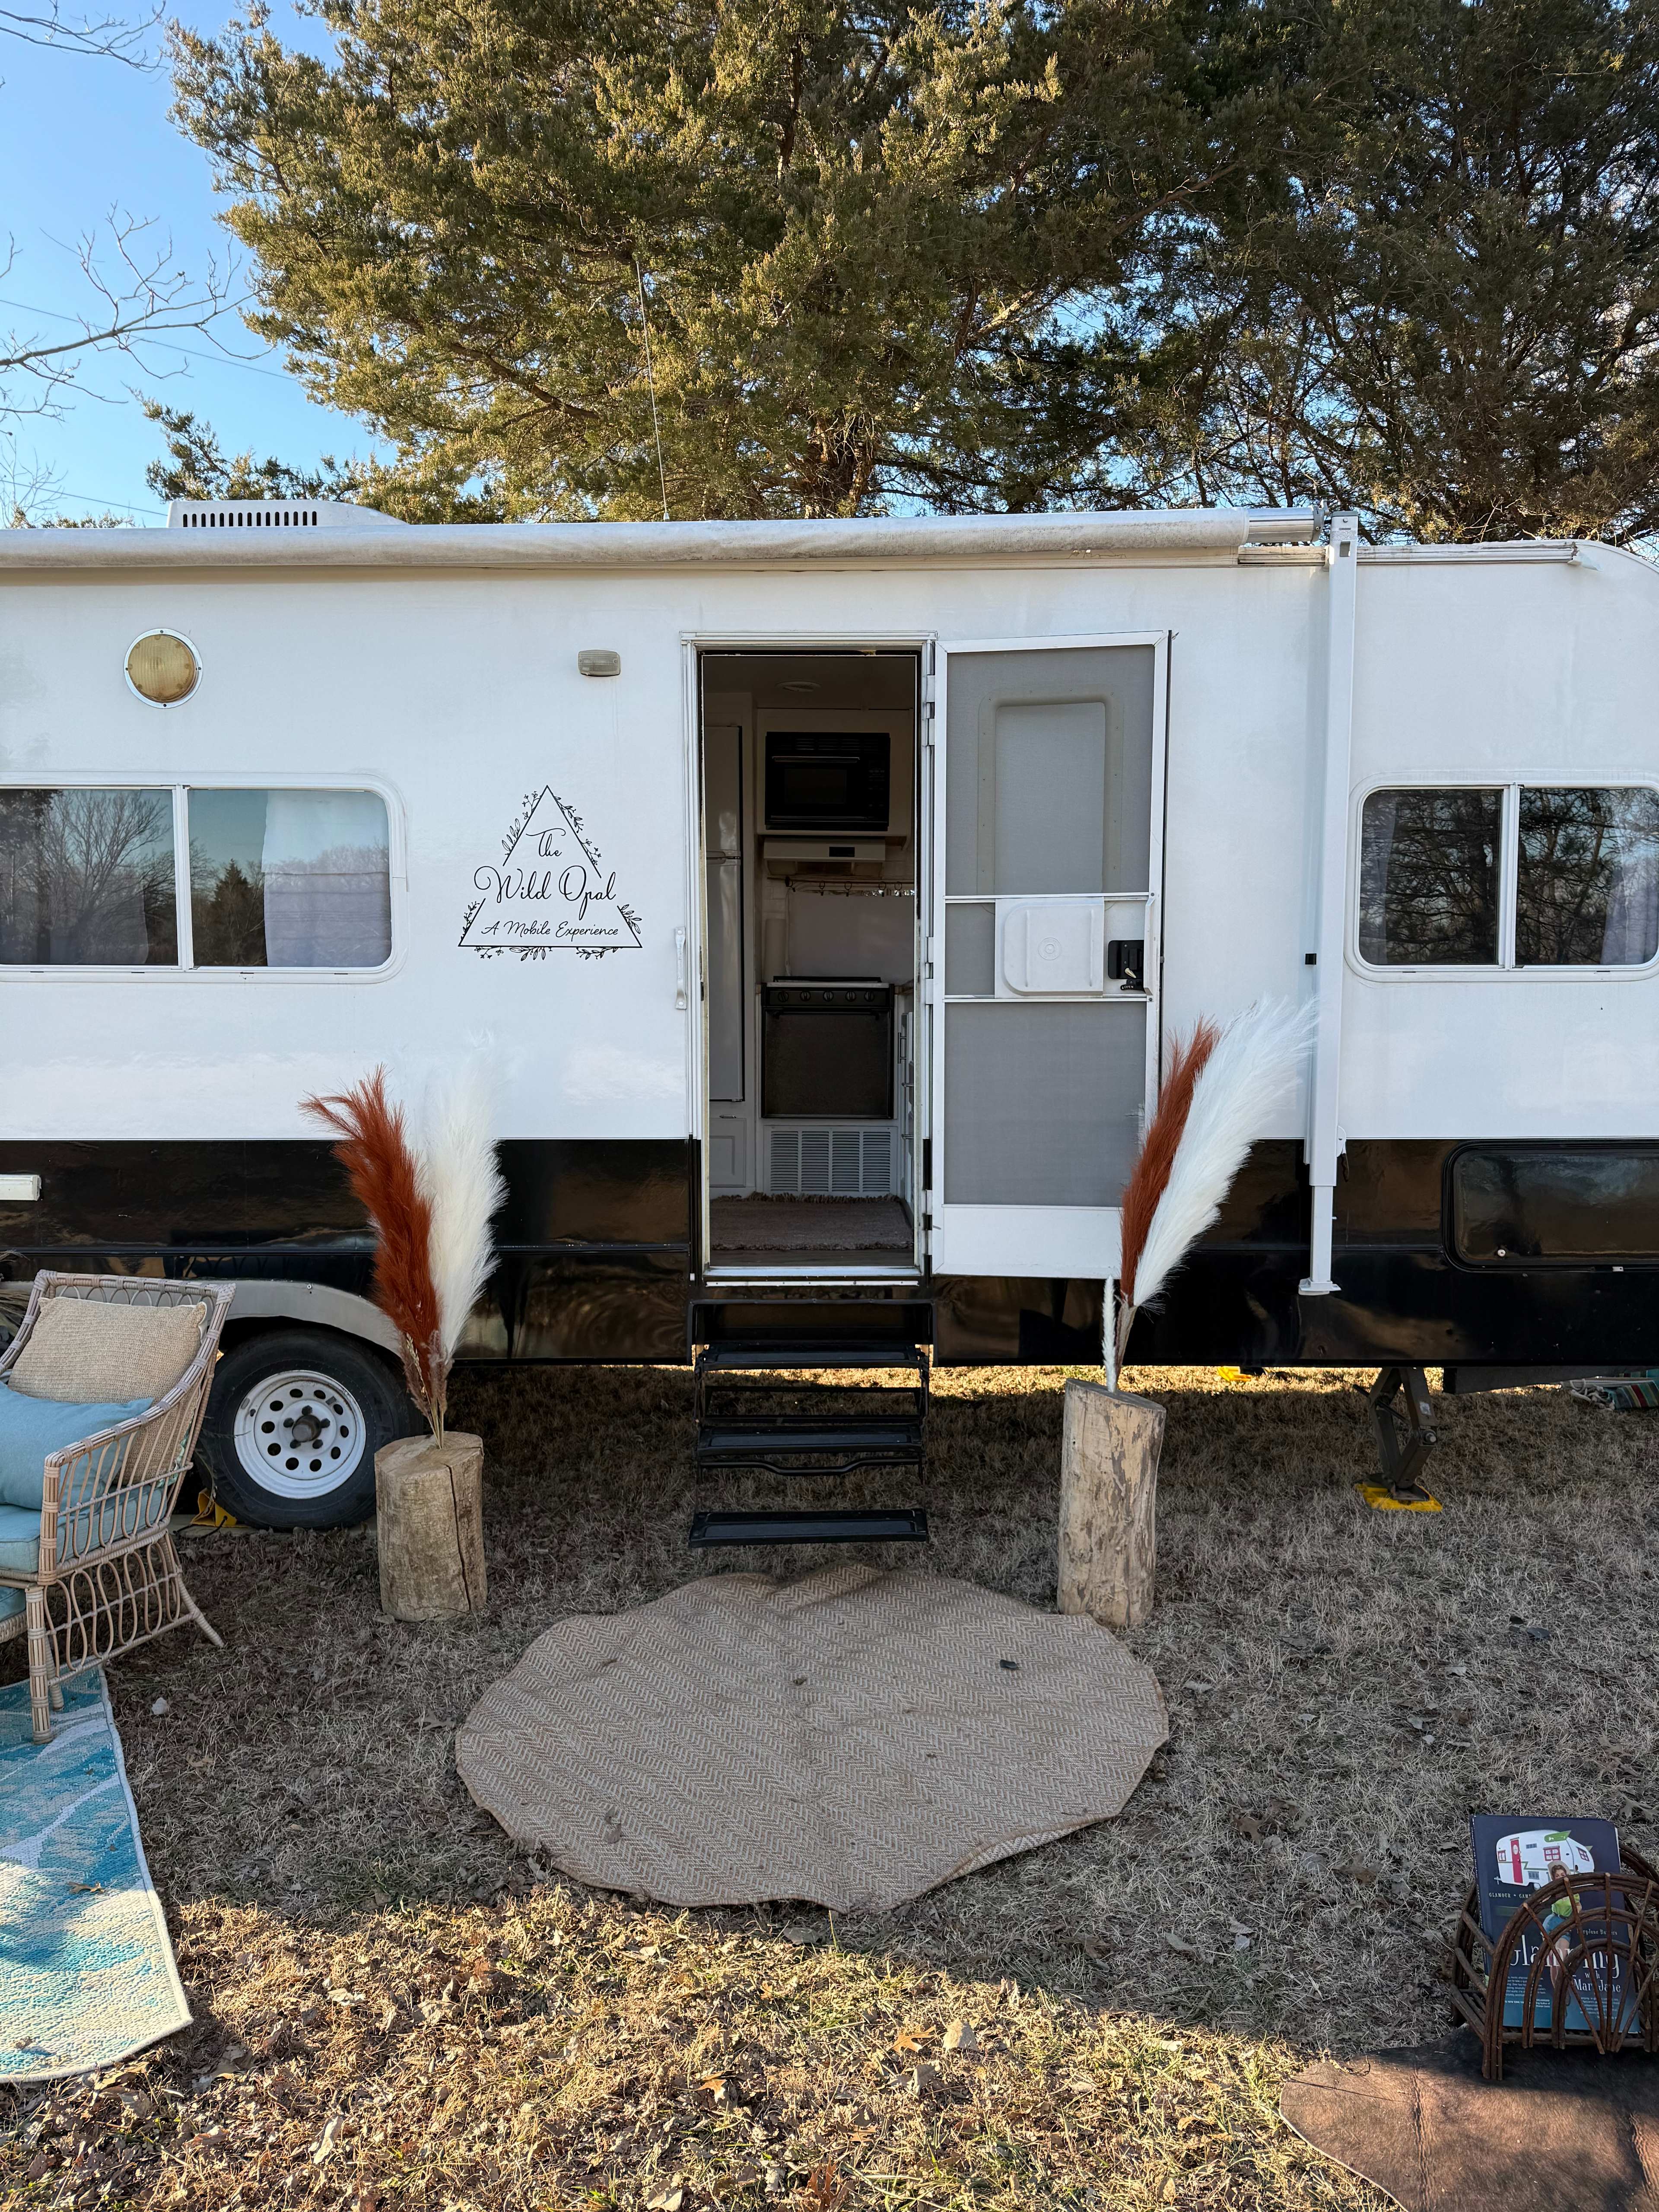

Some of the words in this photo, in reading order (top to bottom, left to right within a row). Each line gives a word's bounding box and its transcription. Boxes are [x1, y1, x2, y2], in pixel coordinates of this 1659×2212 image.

[525, 827, 566, 857] The
[474, 866, 552, 903] Wild
[559, 865, 617, 921] Opal
[481, 921, 499, 935] A
[503, 920, 551, 938] Mobile
[555, 921, 619, 942] Experience
[1585, 1970, 1600, 1979] wh
[1573, 1979, 1595, 1995] Mar
